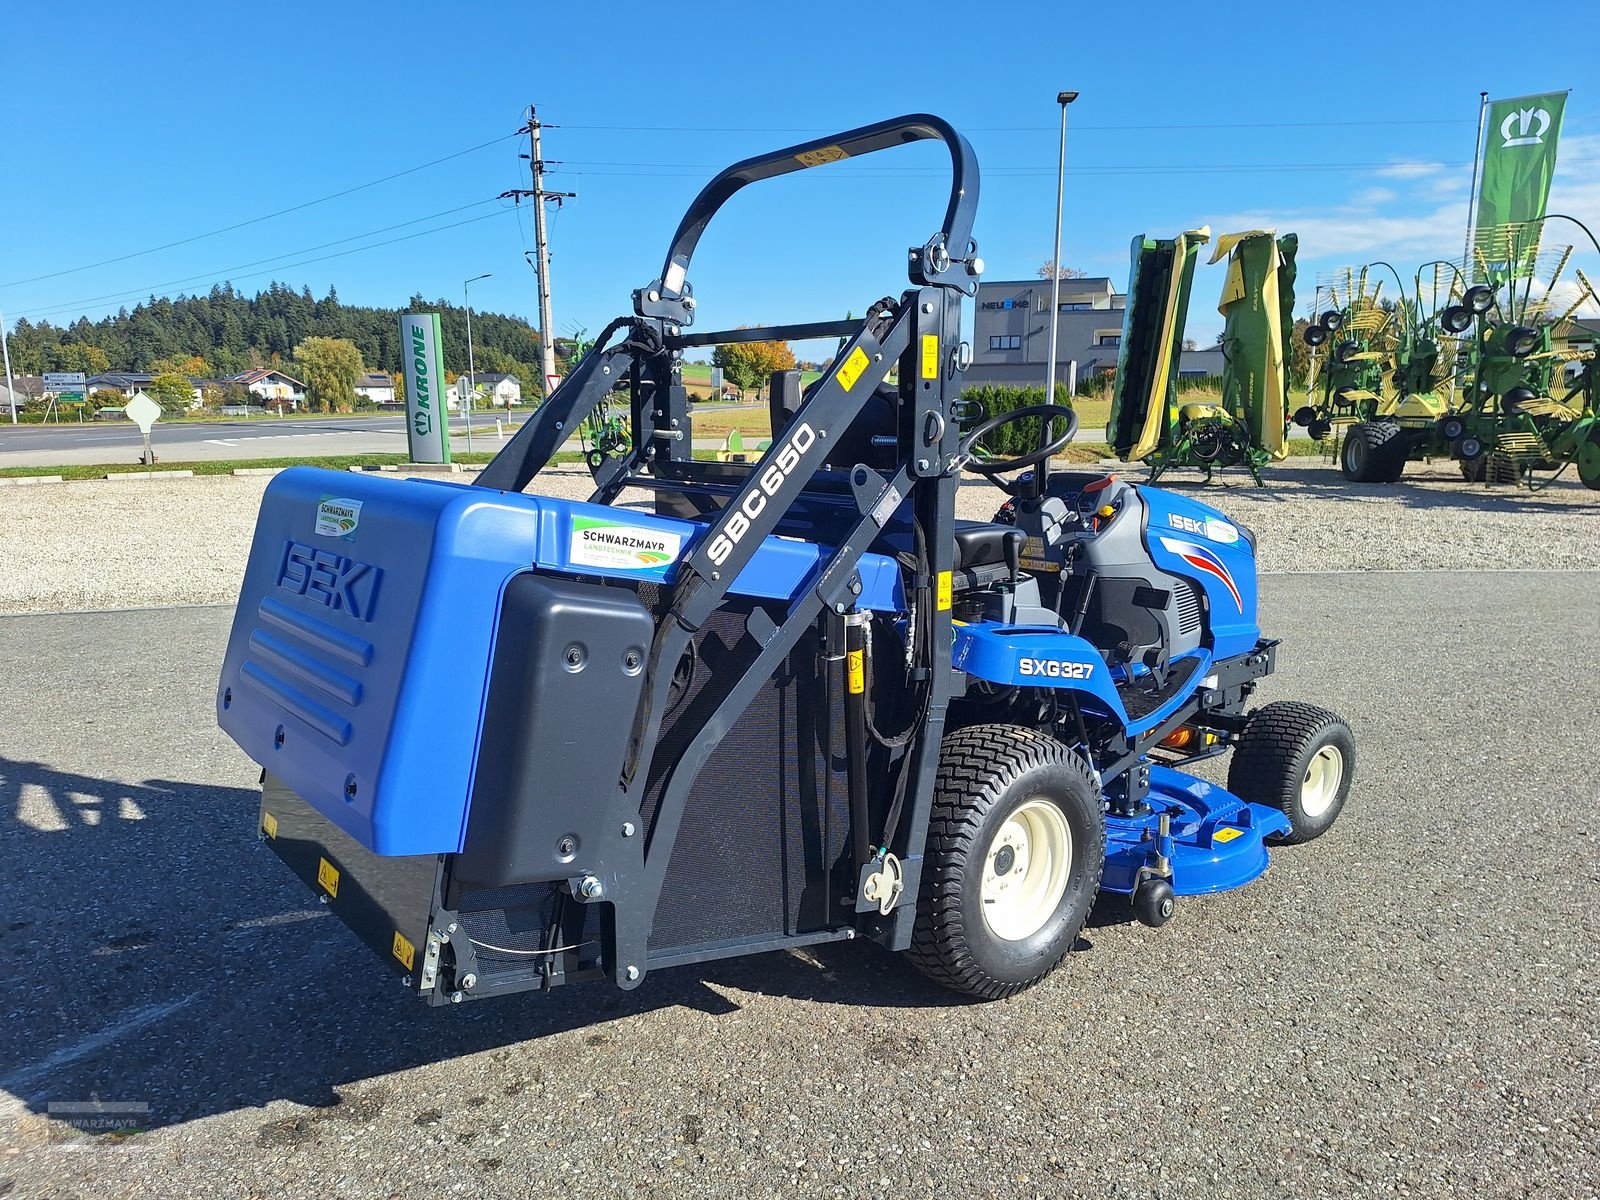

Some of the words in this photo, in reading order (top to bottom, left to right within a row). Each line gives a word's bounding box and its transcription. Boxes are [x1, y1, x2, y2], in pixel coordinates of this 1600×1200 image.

[411, 324, 430, 410] KRONE
[321, 503, 354, 518] SCHWARZMAYR
[1167, 512, 1208, 536] ISEKI
[583, 530, 665, 551] SCHWARZMAYR
[583, 543, 632, 556] LANDTECHNIK
[275, 541, 384, 622] ISEKI
[1019, 657, 1094, 680] SXG327
